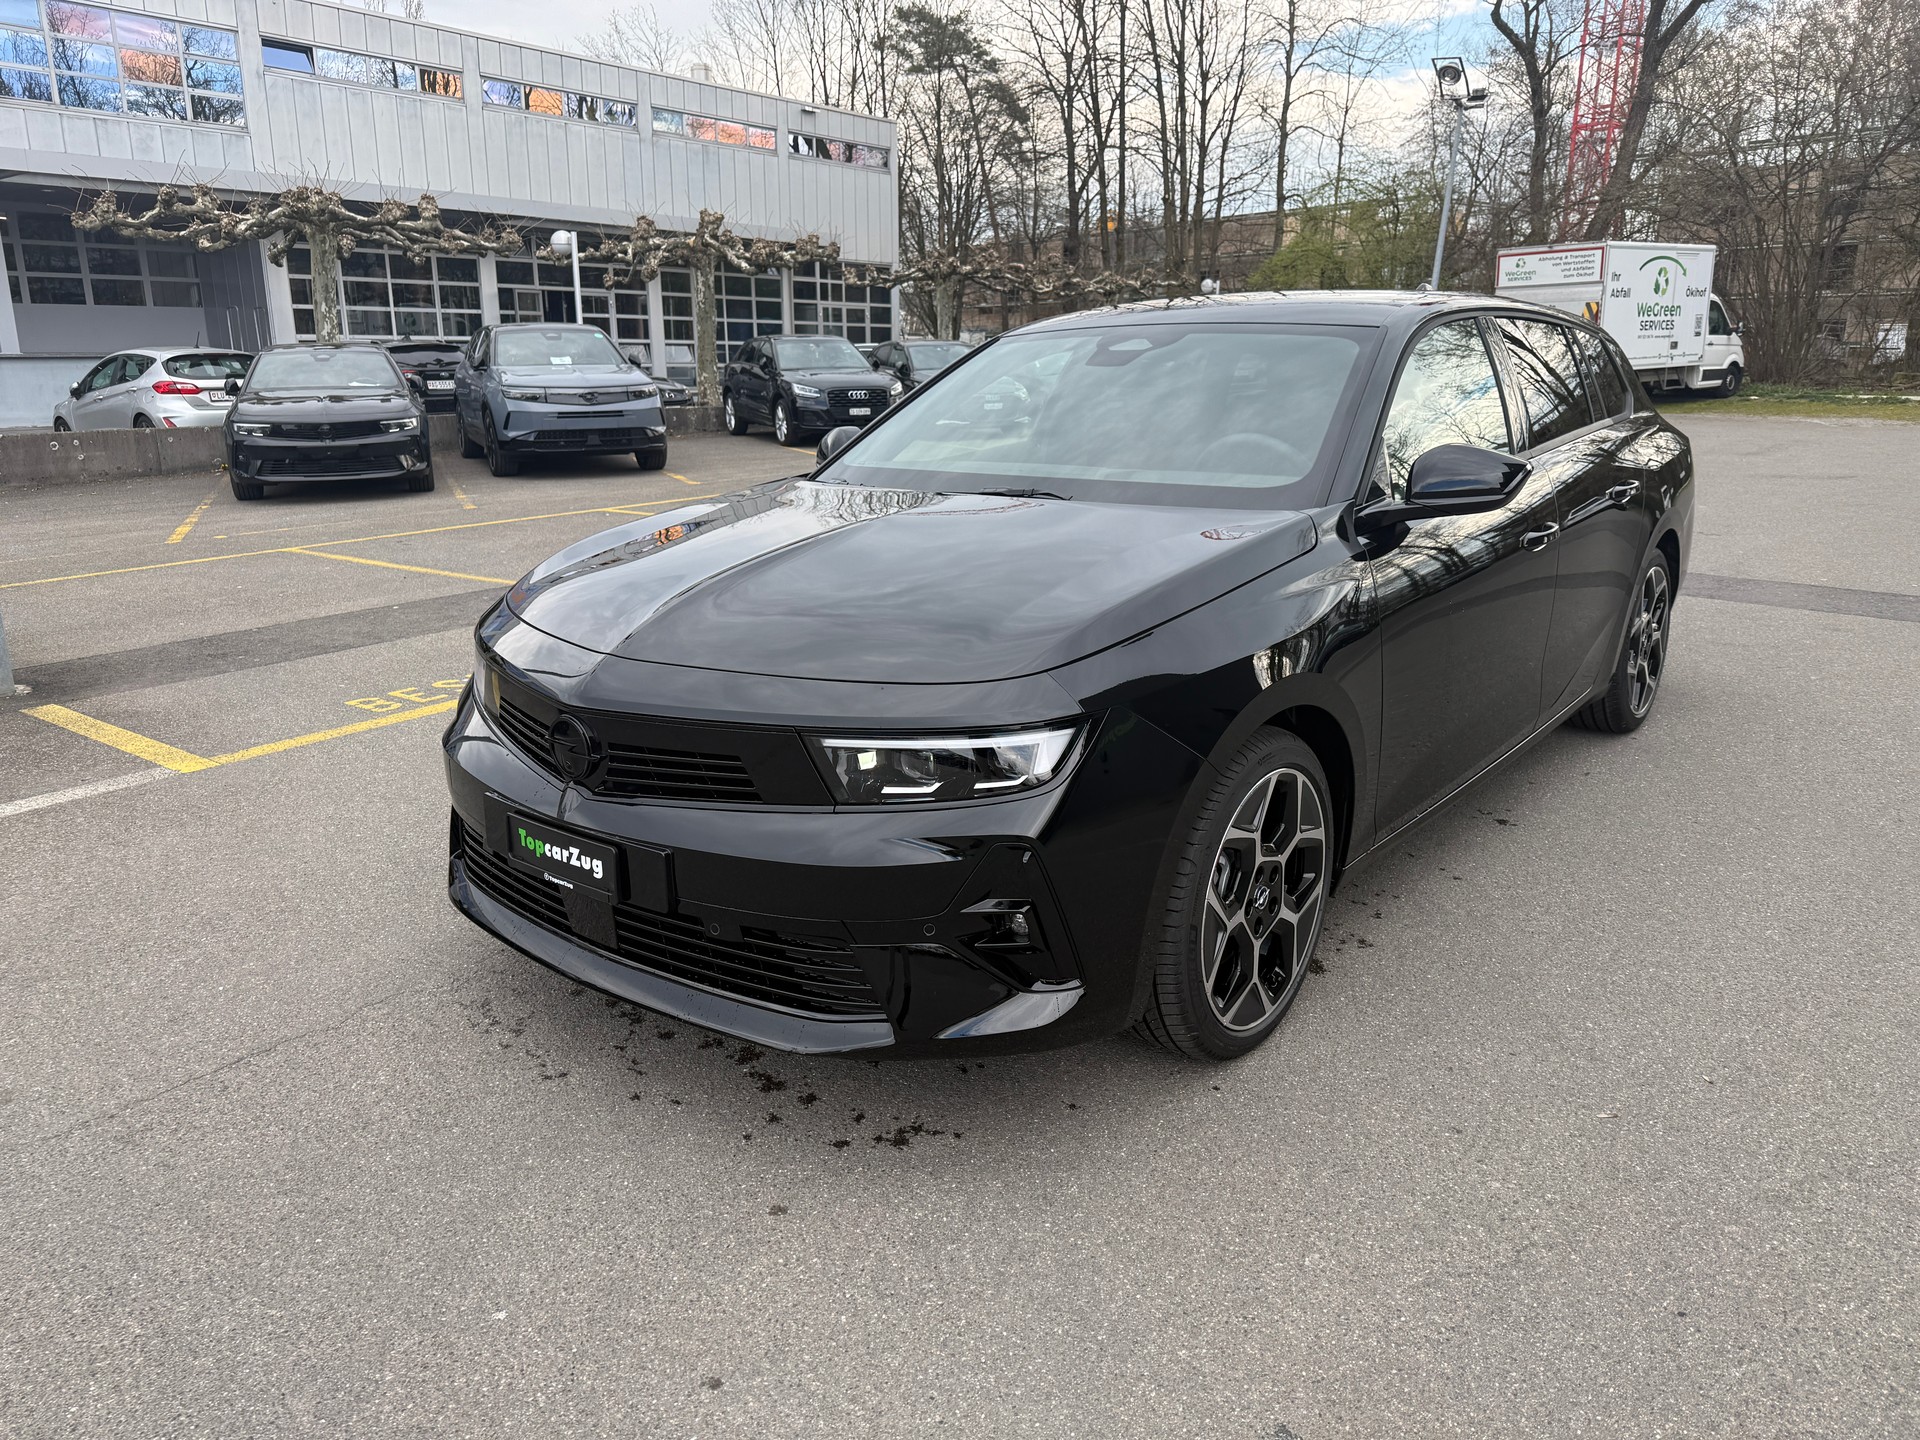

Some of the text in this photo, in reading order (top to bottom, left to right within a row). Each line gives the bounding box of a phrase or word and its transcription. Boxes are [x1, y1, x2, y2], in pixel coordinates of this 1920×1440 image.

[1505, 269, 1536, 277] WeGreen
[1611, 272, 1621, 282] Ihr
[1610, 287, 1631, 298] Abfall
[1685, 285, 1707, 298] Ökihof
[1637, 302, 1681, 317] WeGreen
[1639, 320, 1675, 331] SERVICES
[518, 828, 603, 879] TopcarZug
